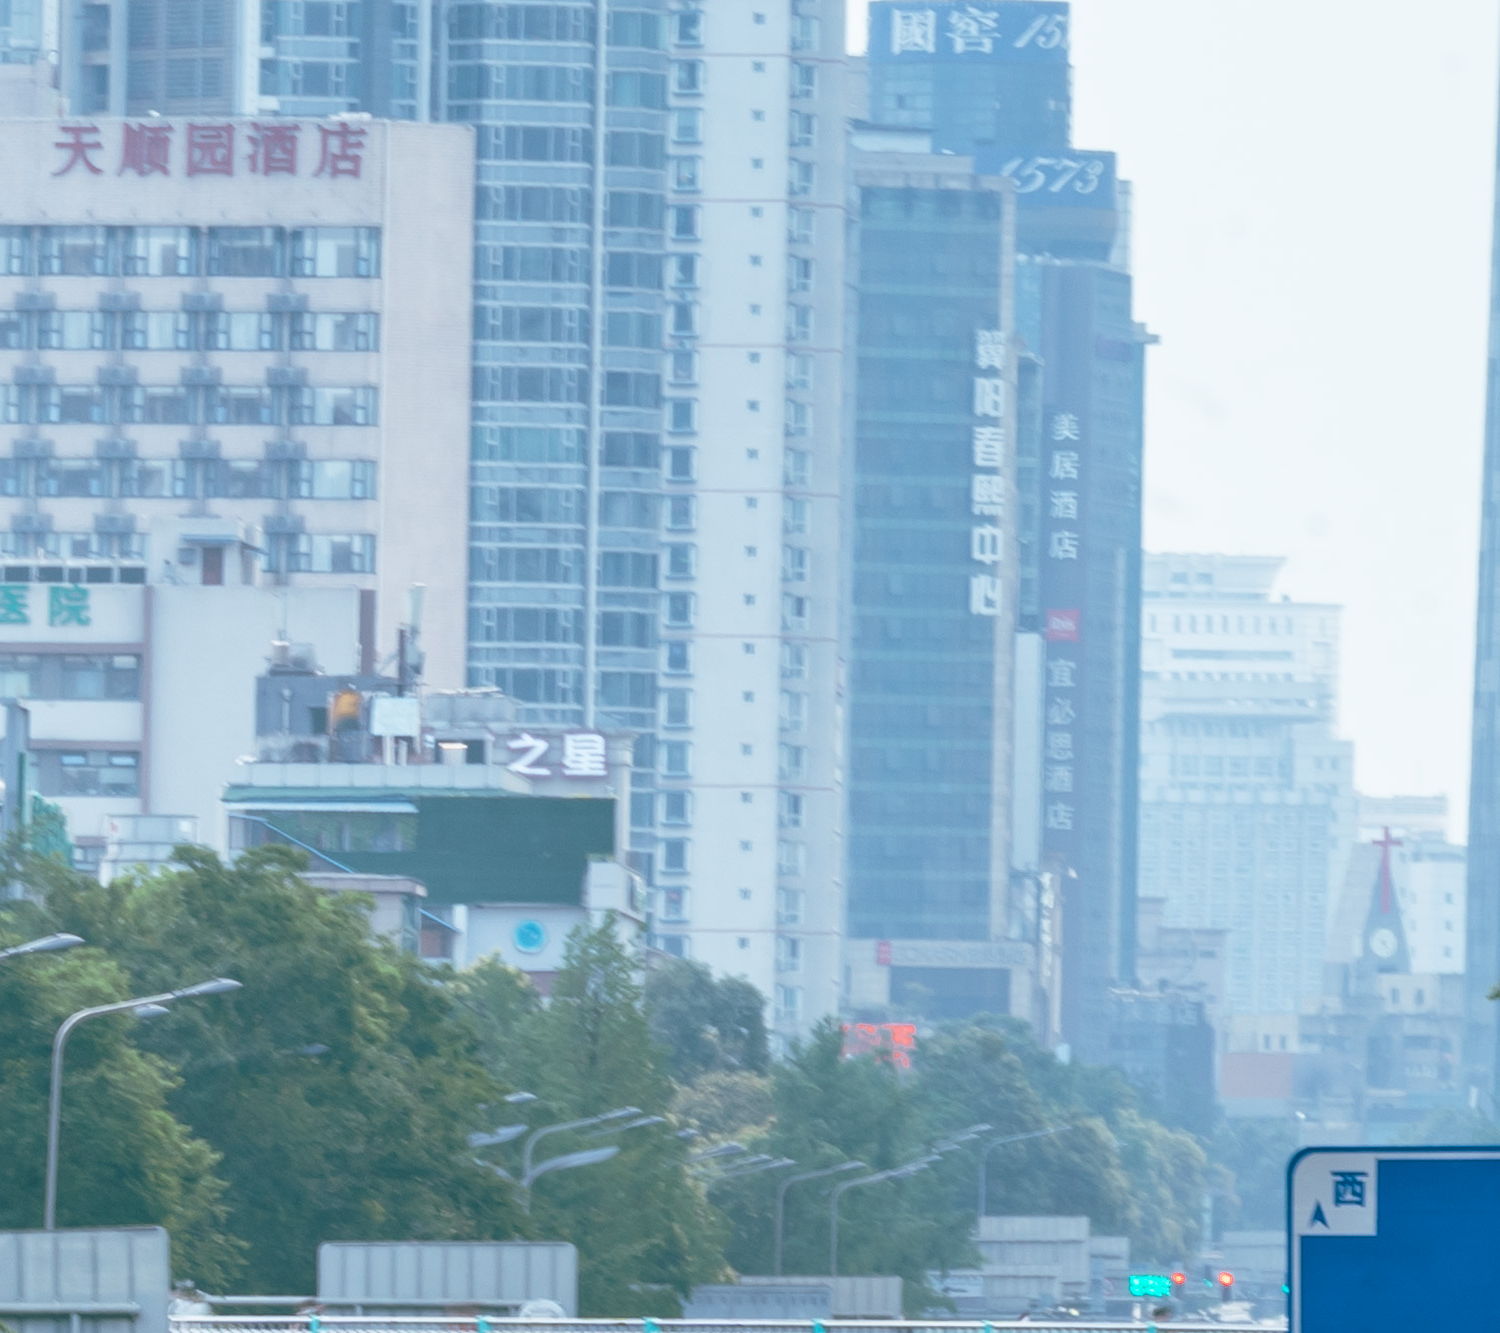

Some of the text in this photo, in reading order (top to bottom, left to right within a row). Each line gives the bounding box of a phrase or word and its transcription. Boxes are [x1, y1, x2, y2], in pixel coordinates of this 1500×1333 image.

[890, 6, 1002, 55] 國窖
[51, 122, 368, 180] 天顺园酒店
[1048, 410, 1081, 561] 美居酒店
[506, 732, 609, 776] 之星
[1045, 658, 1077, 831] 宜必思酒店
[1330, 1171, 1369, 1208] 西
